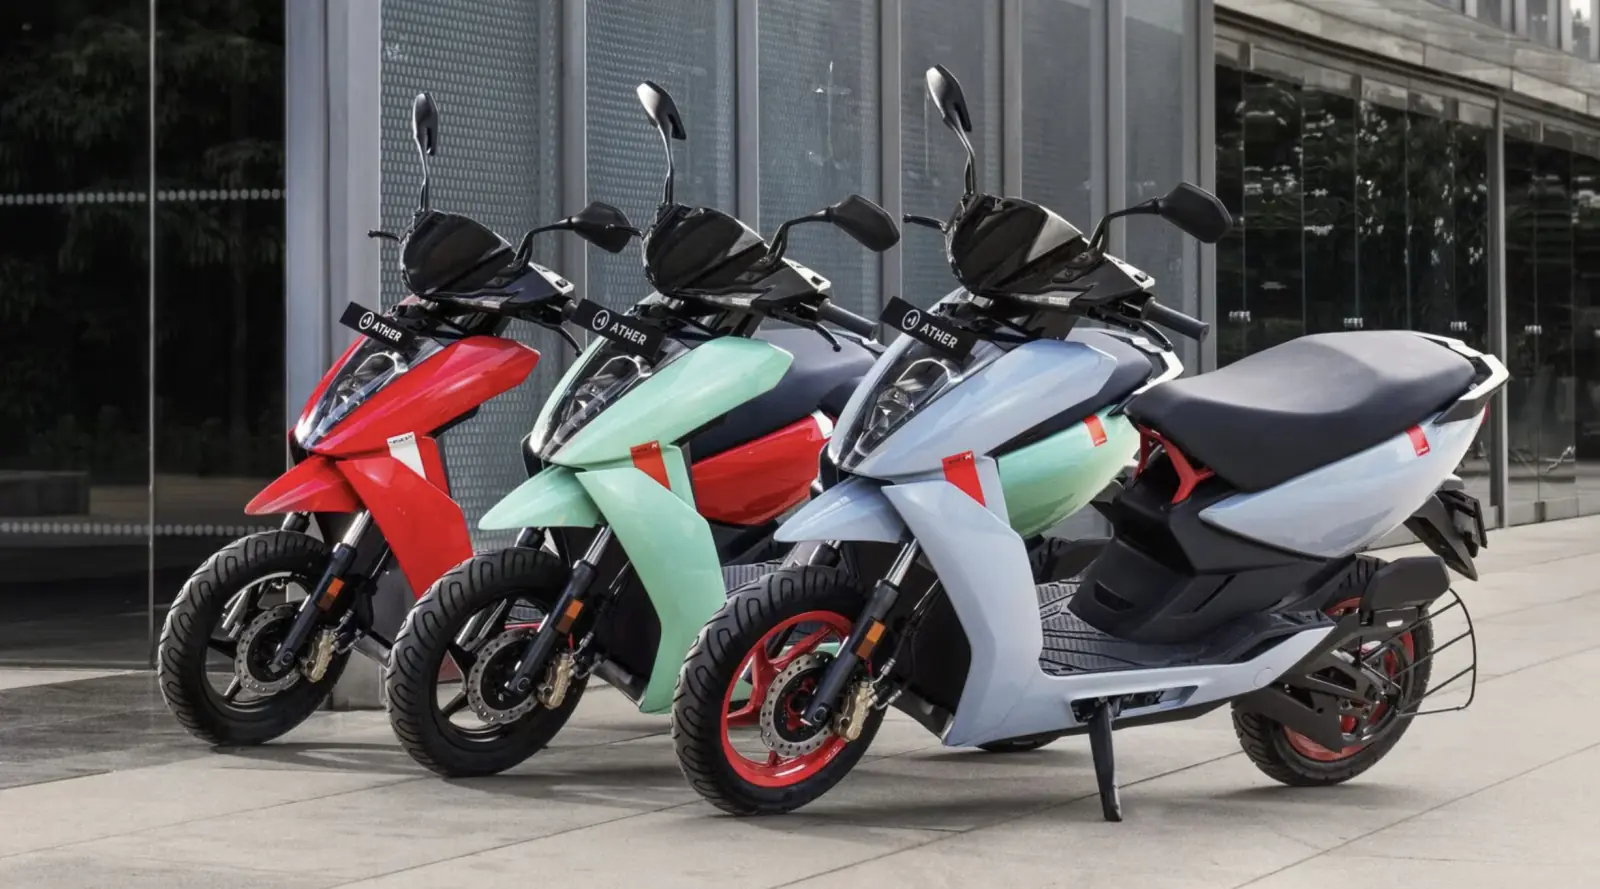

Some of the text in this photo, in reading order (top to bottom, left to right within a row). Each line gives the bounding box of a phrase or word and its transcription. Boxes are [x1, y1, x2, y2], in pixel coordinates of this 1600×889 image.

[372, 321, 402, 342] ATHER
[609, 322, 648, 346] ATHER
[919, 323, 959, 349] ATHER
